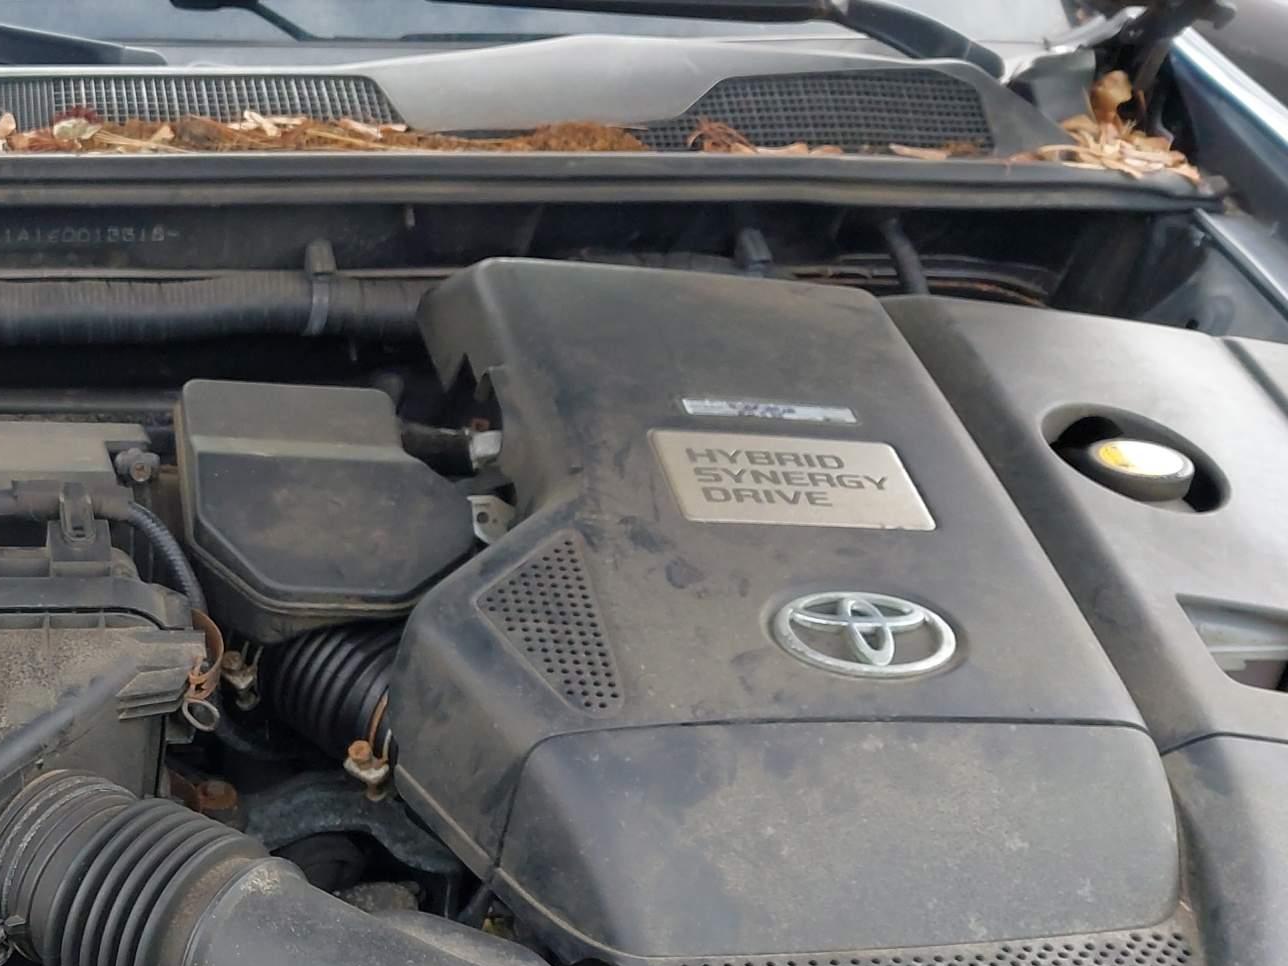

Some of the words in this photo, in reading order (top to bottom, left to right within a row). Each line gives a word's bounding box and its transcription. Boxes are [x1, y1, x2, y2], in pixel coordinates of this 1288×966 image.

[685, 448, 845, 470] HYBRID
[693, 466, 889, 491] SYNERGY
[701, 486, 833, 508] DRIVE
